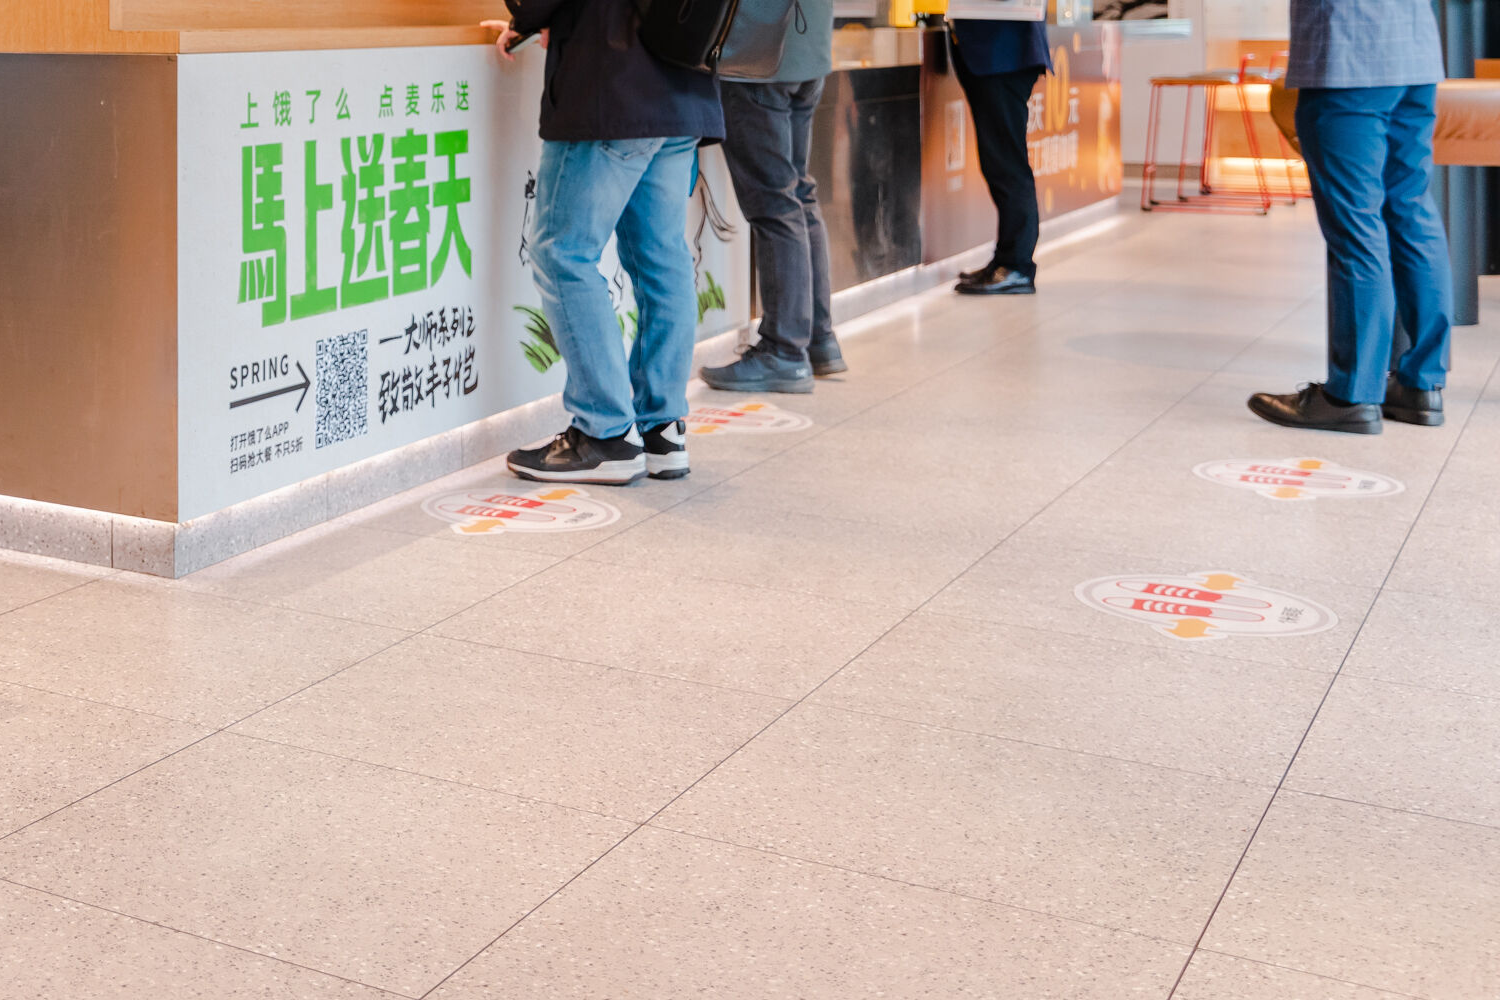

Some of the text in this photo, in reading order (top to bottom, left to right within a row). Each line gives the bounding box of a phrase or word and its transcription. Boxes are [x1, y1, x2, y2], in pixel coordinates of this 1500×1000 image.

[240, 80, 470, 129] 上饿了么 点麦乐送
[229, 354, 289, 390] SPRING
